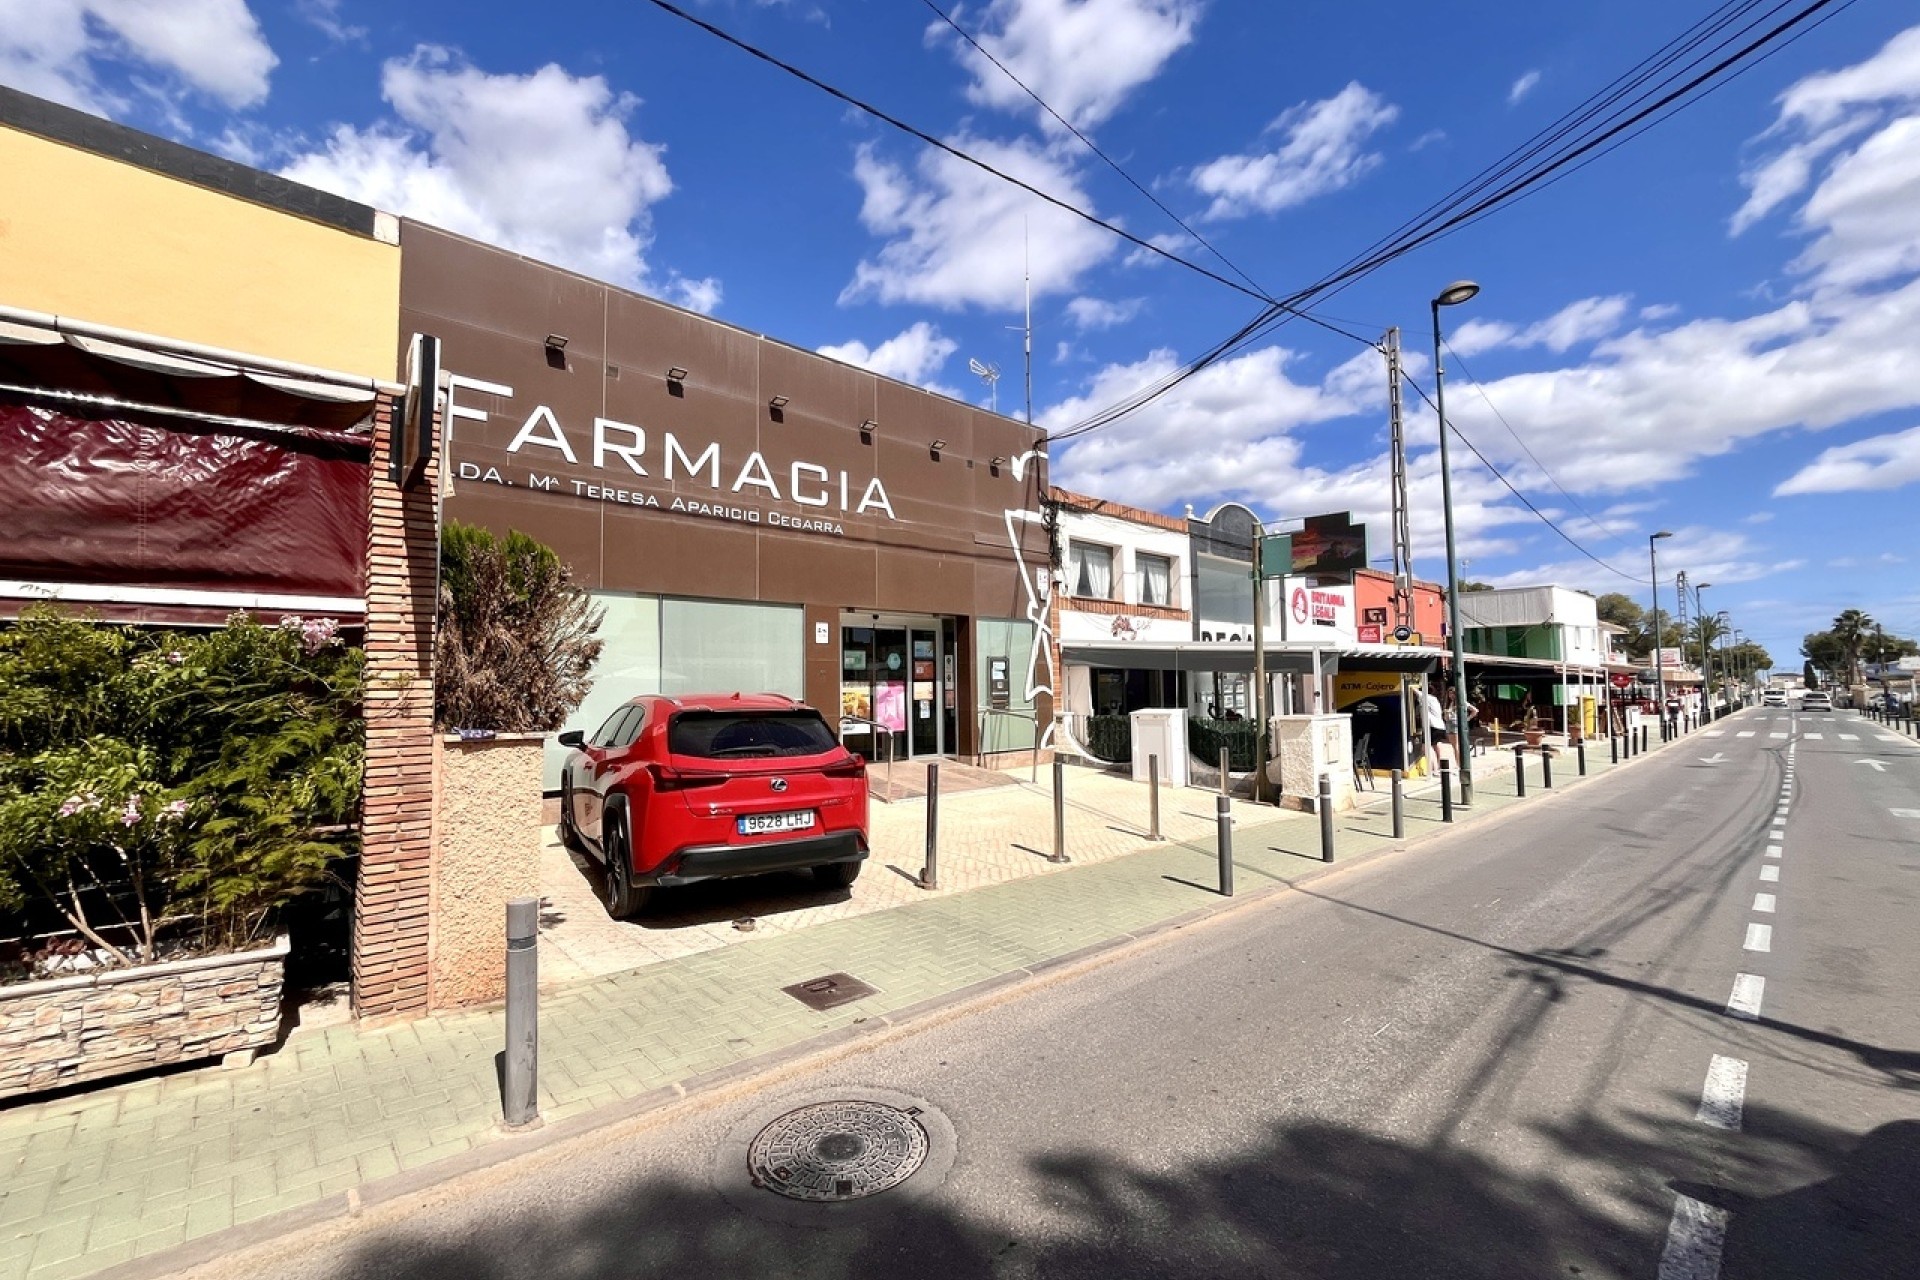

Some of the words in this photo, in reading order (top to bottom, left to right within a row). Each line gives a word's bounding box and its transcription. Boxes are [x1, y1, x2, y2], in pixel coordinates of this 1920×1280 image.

[446, 374, 896, 520] FARMACIA
[451, 462, 514, 486] DA.
[570, 479, 660, 508] TERESA
[671, 496, 760, 522] APARICIO
[768, 511, 844, 535] CEGARRA
[749, 815, 782, 830] 9628
[786, 812, 811, 827] LHJ
